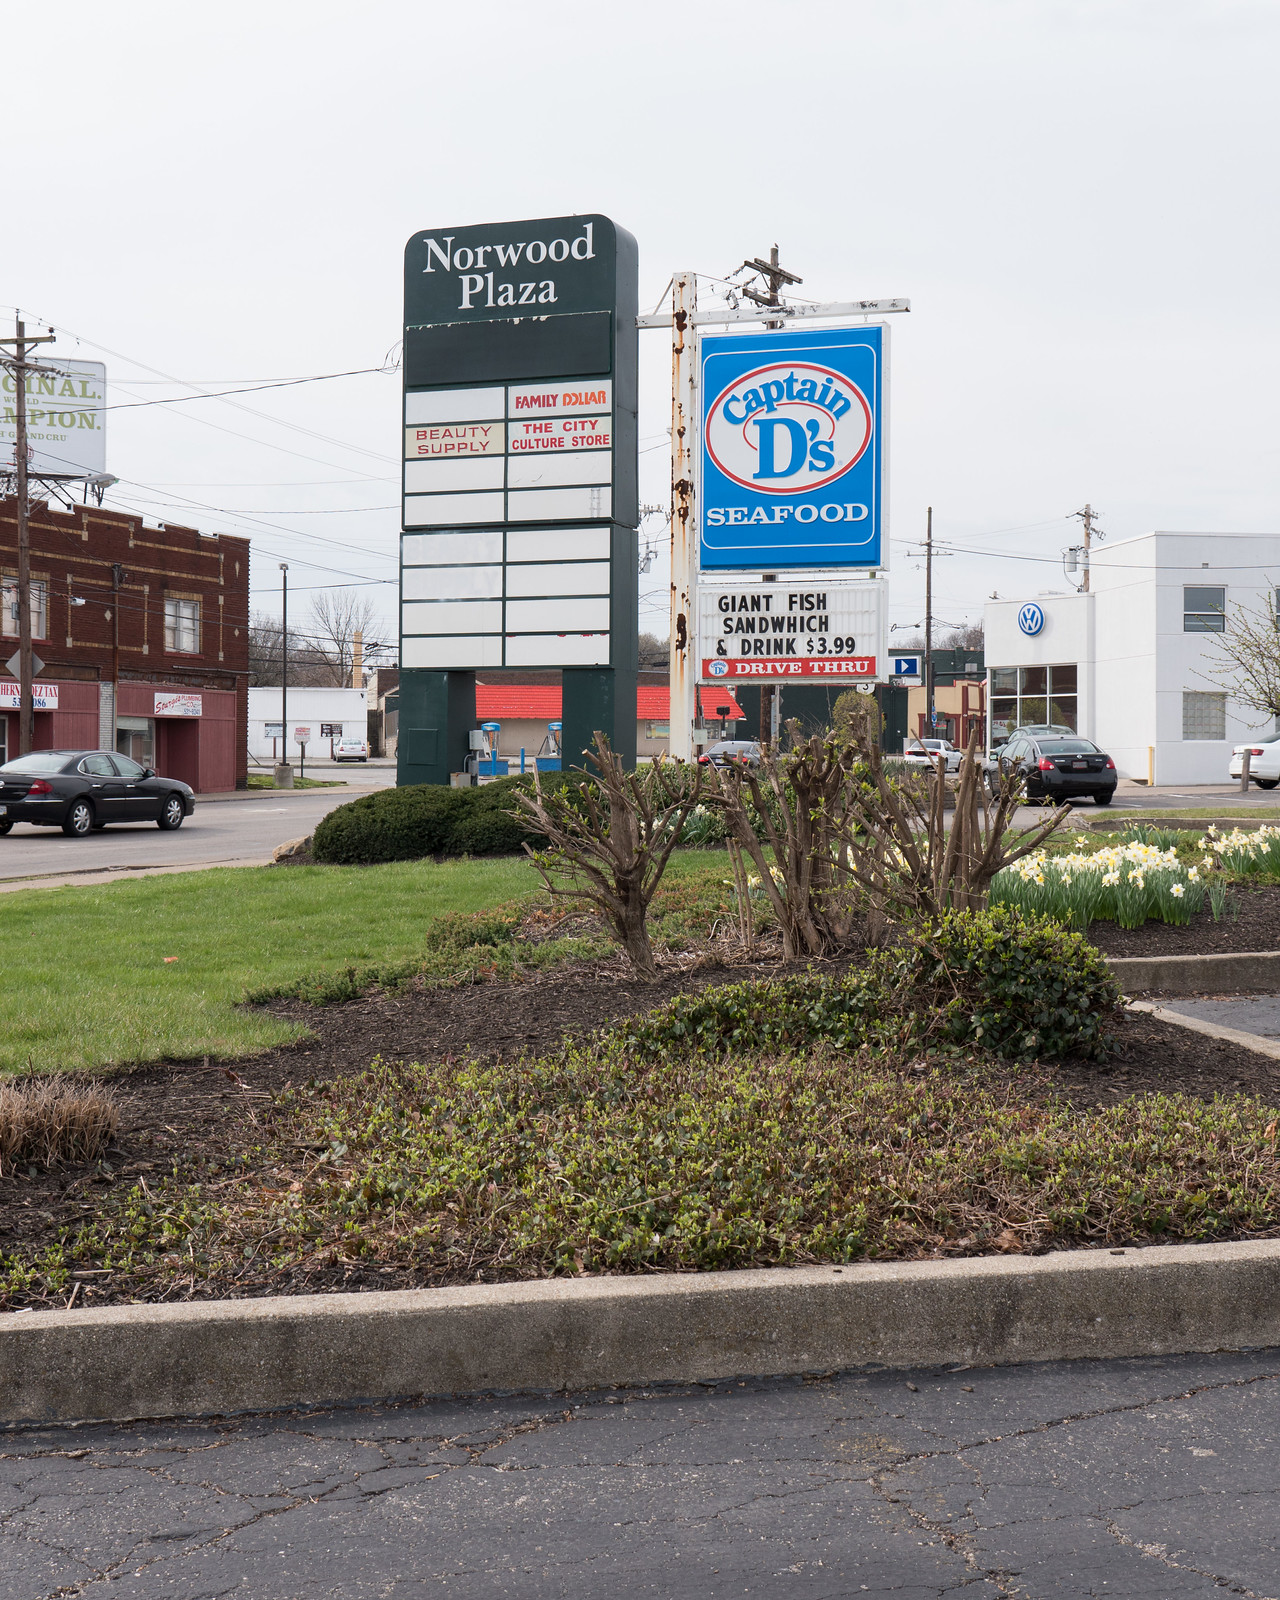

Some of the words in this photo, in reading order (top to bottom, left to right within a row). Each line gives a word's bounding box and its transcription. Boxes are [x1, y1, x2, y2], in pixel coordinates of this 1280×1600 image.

[422, 222, 596, 273] Norwood
[457, 271, 559, 310] Plaza
[4, 396, 39, 405] WOLD
[515, 394, 559, 409] FAMILY
[562, 390, 607, 407] DOLLAR
[722, 371, 852, 425] Captain
[0, 406, 101, 431] MPION.
[523, 422, 553, 435] THE
[562, 419, 599, 432] CITY
[46, 433, 67, 442] CRU
[416, 426, 492, 441] BEAUTY
[512, 437, 565, 450] CULTURE
[571, 434, 610, 447] STORE
[417, 441, 491, 455] SUPPLY
[753, 417, 835, 479] D's
[706, 503, 869, 527] SEAFOOD
[718, 594, 773, 613] GIANT
[788, 592, 827, 611] FISH
[723, 615, 829, 634] SANDWHICH
[716, 639, 727, 656] &
[741, 638, 797, 656] DRINK
[806, 636, 856, 655] $3.99
[735, 661, 802, 674] DRIVE
[809, 661, 870, 673] THRU
[0, 684, 43, 697] HERNDEZ
[45, 686, 58, 698] TAX
[12, 697, 47, 708] 53086
